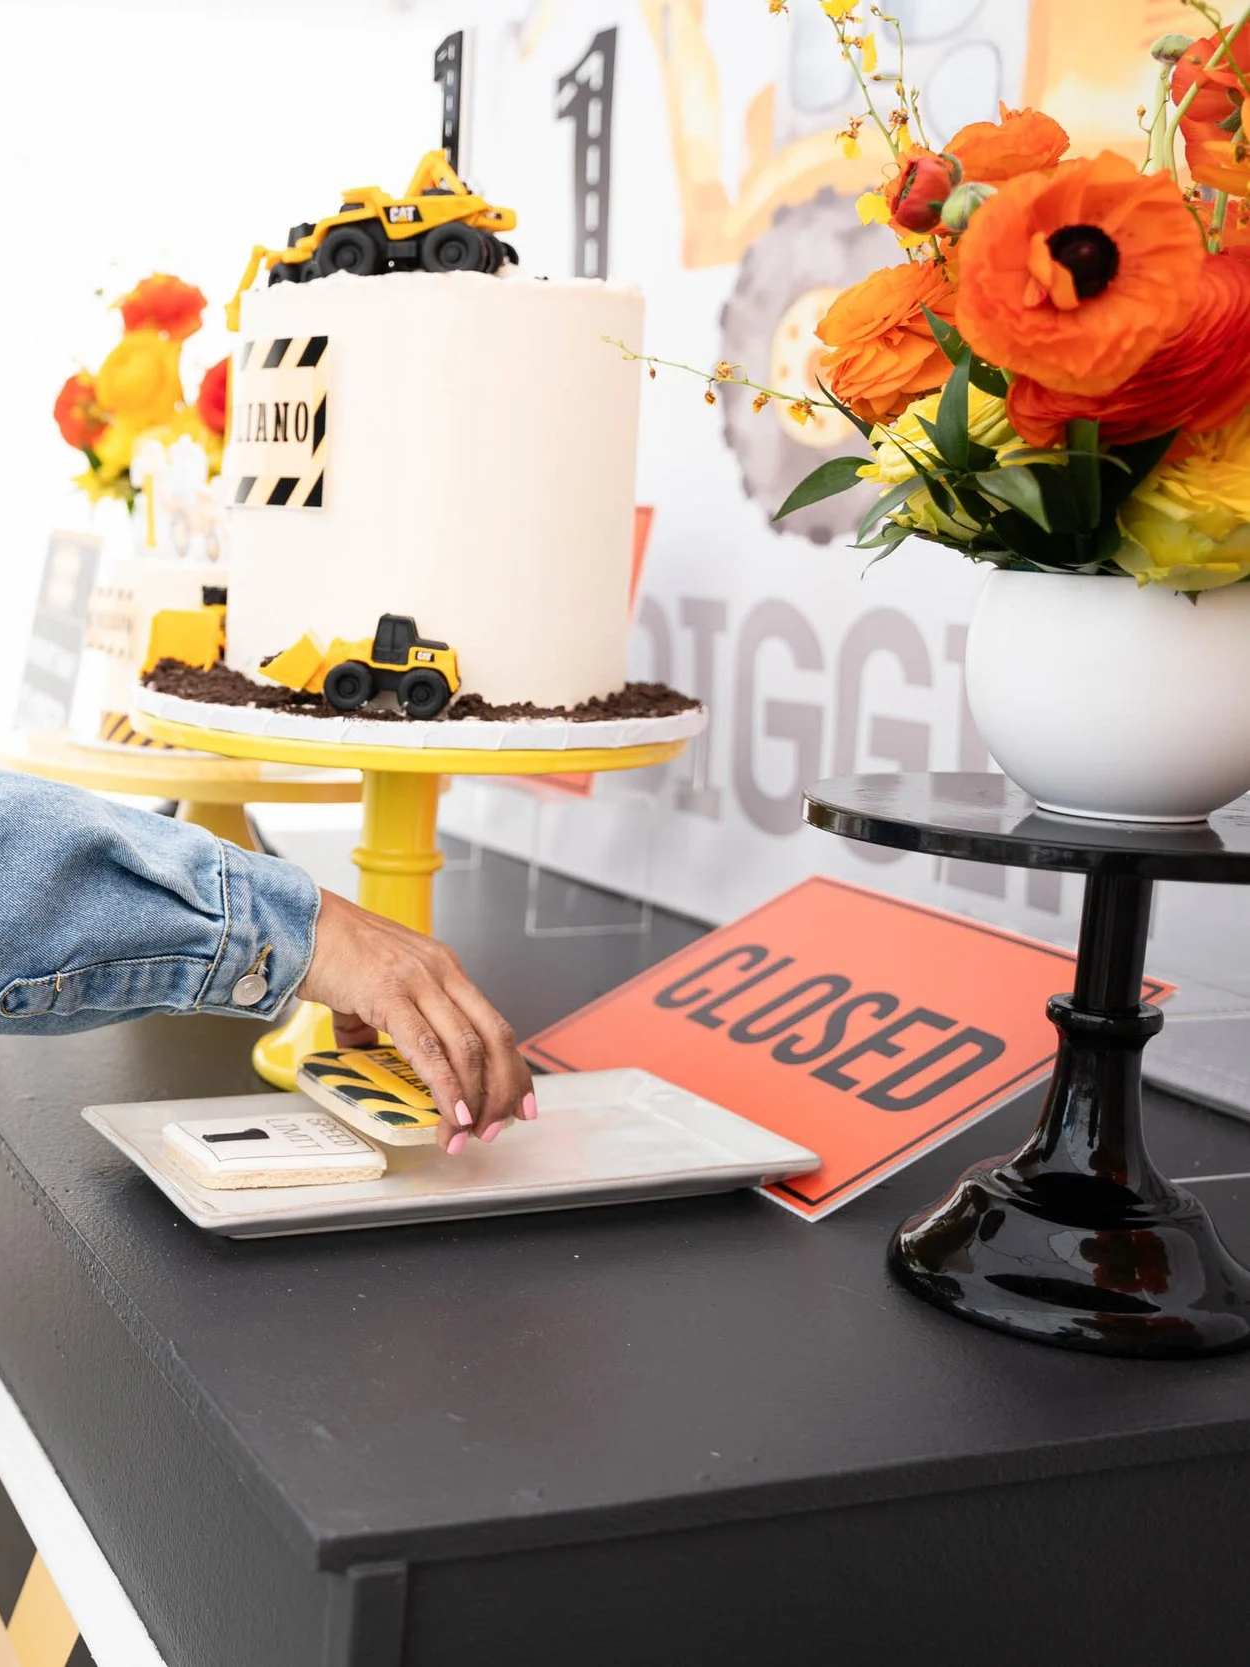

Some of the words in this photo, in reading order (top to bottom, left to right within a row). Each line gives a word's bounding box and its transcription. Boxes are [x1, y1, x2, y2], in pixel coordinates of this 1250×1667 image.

[389, 205, 416, 223] CAT
[653, 943, 1006, 1113] CLOSED
[266, 1117, 325, 1150] LIMIT
[307, 1116, 358, 1148] SPEED
